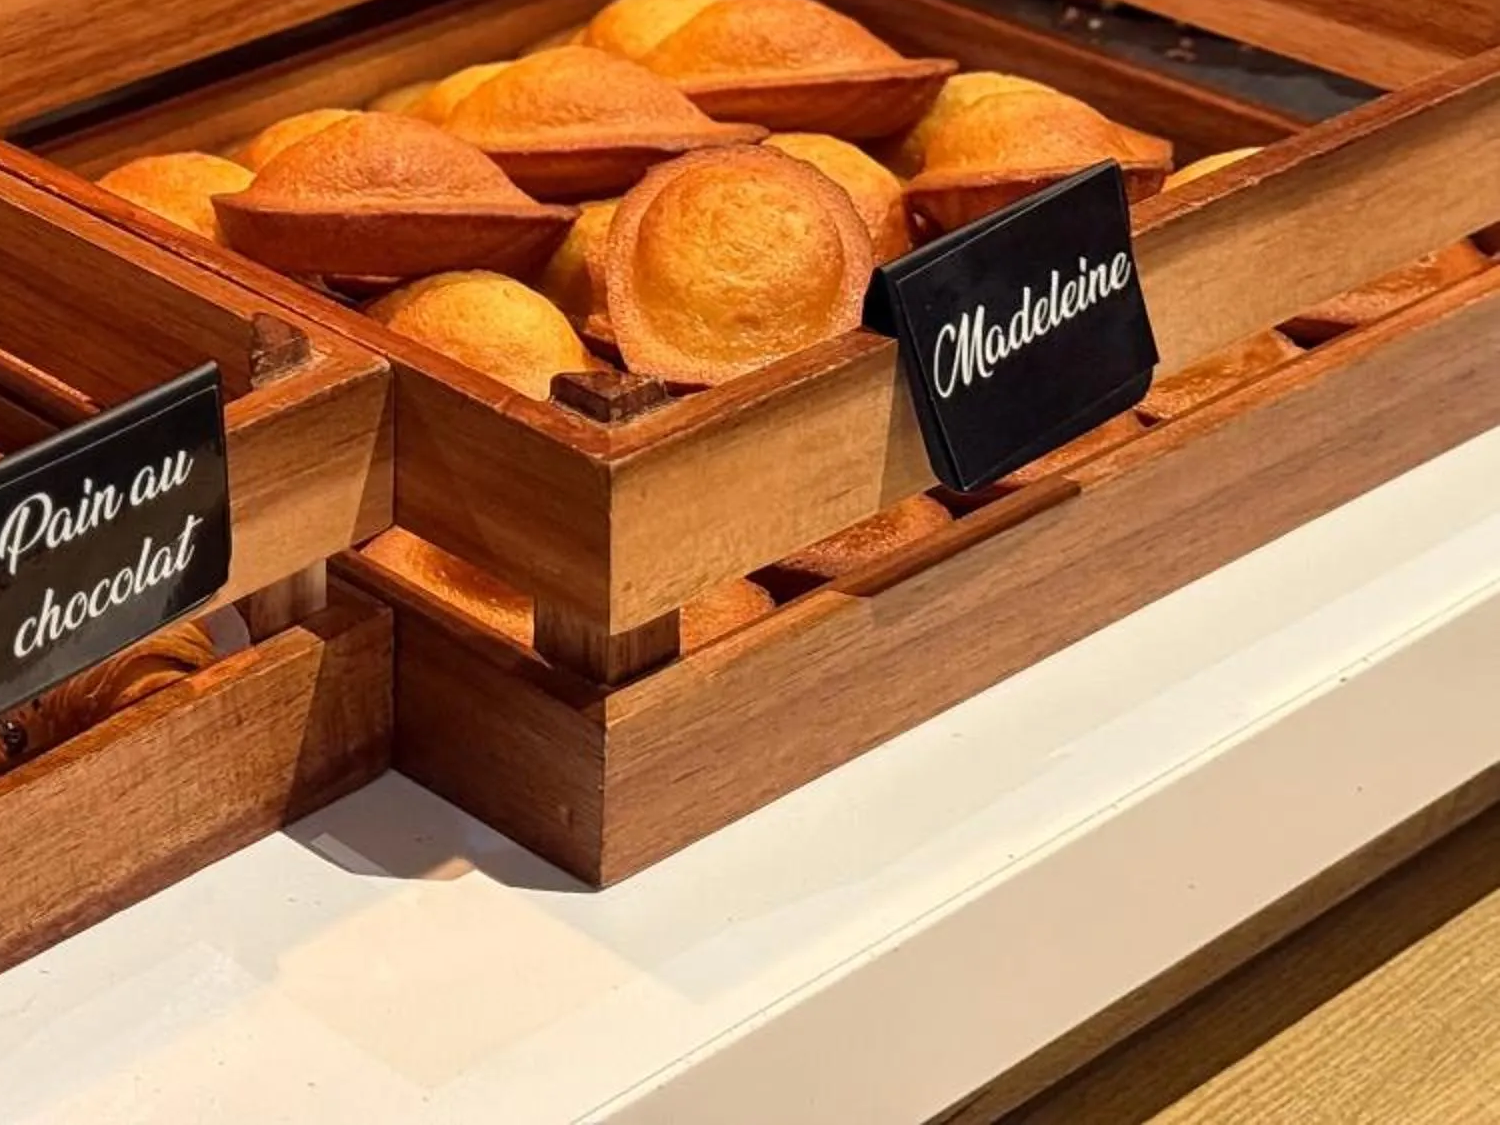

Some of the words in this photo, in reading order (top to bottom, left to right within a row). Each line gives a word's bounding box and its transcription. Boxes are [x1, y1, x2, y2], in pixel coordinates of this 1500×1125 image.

[932, 251, 1132, 398] Madeleine
[130, 450, 194, 507] au
[12, 514, 204, 659] chocolat
